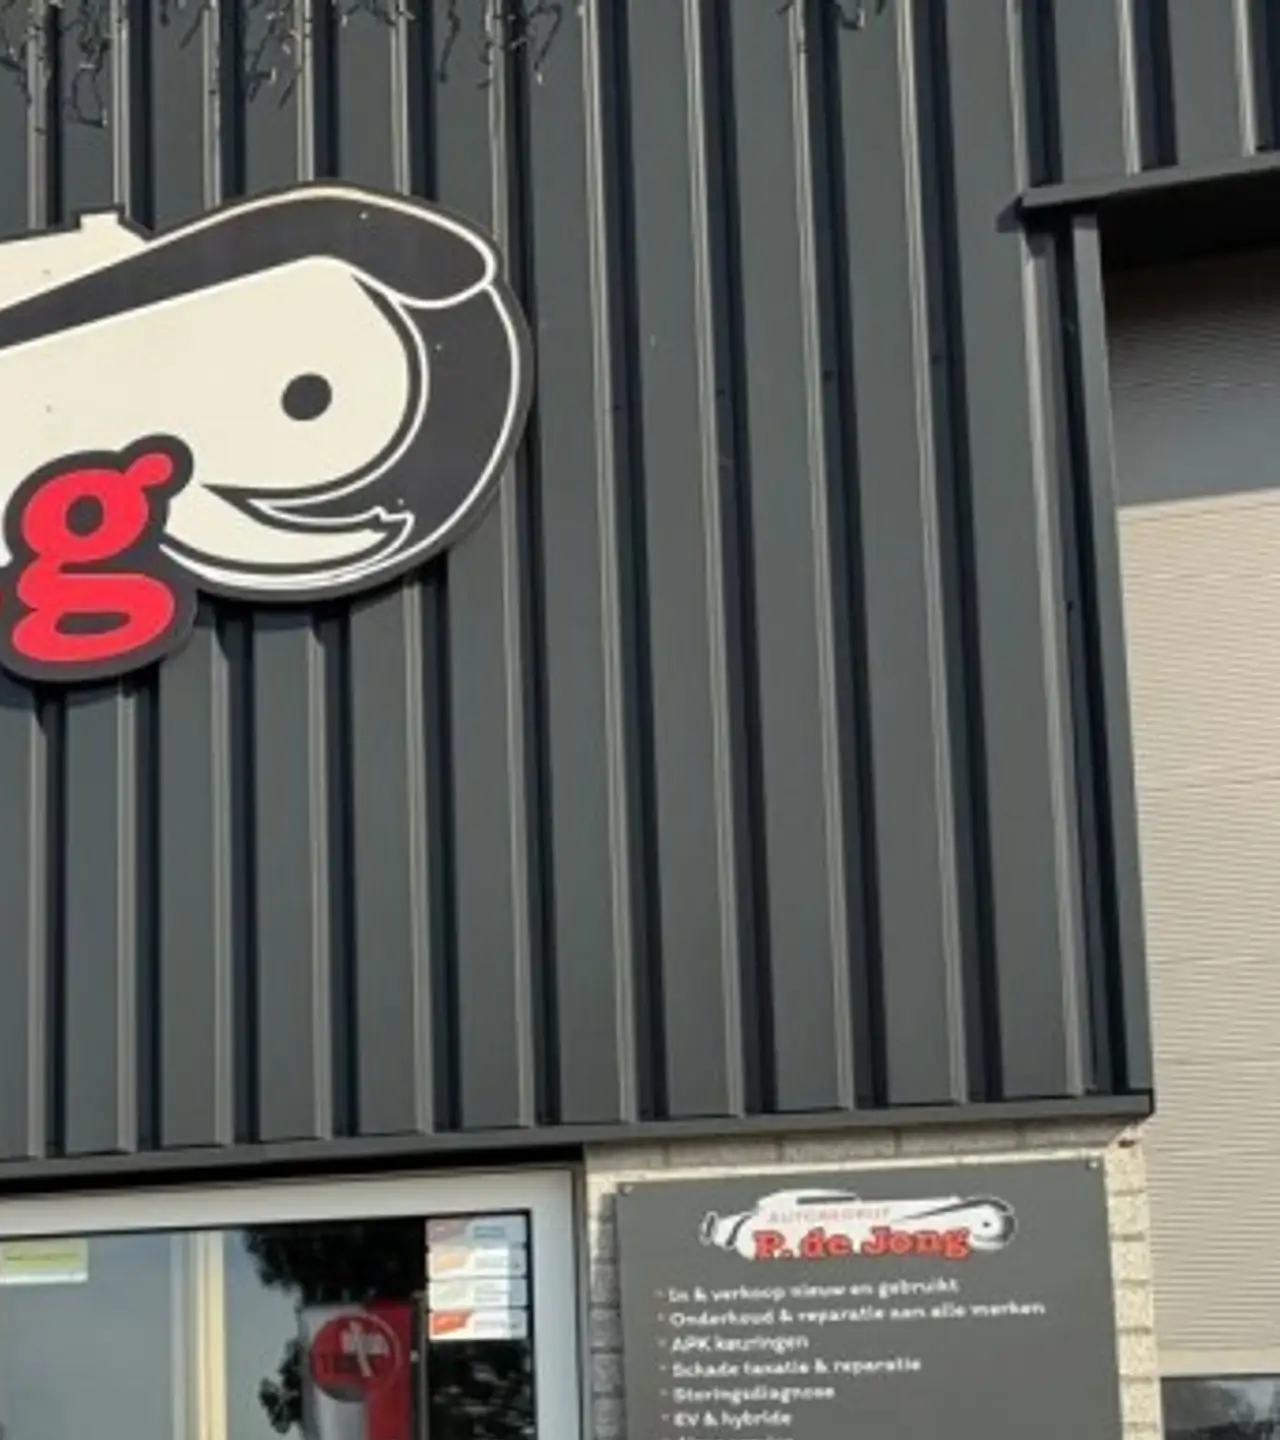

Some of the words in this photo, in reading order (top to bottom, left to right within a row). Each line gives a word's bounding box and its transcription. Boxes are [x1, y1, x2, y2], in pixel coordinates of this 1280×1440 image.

[753, 1229, 793, 1261] P.
[800, 1226, 853, 1260] de
[862, 1225, 970, 1260] Jong
[710, 1284, 787, 1303] verkoop
[789, 1284, 846, 1298] nieuw
[848, 1284, 874, 1296] en
[877, 1276, 960, 1300] gebruikt
[668, 1309, 775, 1328] Onderhoud
[796, 1304, 885, 1326] reparatie
[890, 1307, 927, 1320] aan
[930, 1302, 968, 1319] alle
[969, 1300, 1046, 1317] merken
[671, 1335, 712, 1353] APK
[714, 1335, 810, 1355] keuringen
[671, 1361, 739, 1378] Schade
[743, 1360, 810, 1375] taxatie
[832, 1357, 922, 1377] reparatie
[721, 1410, 793, 1430] hybride
